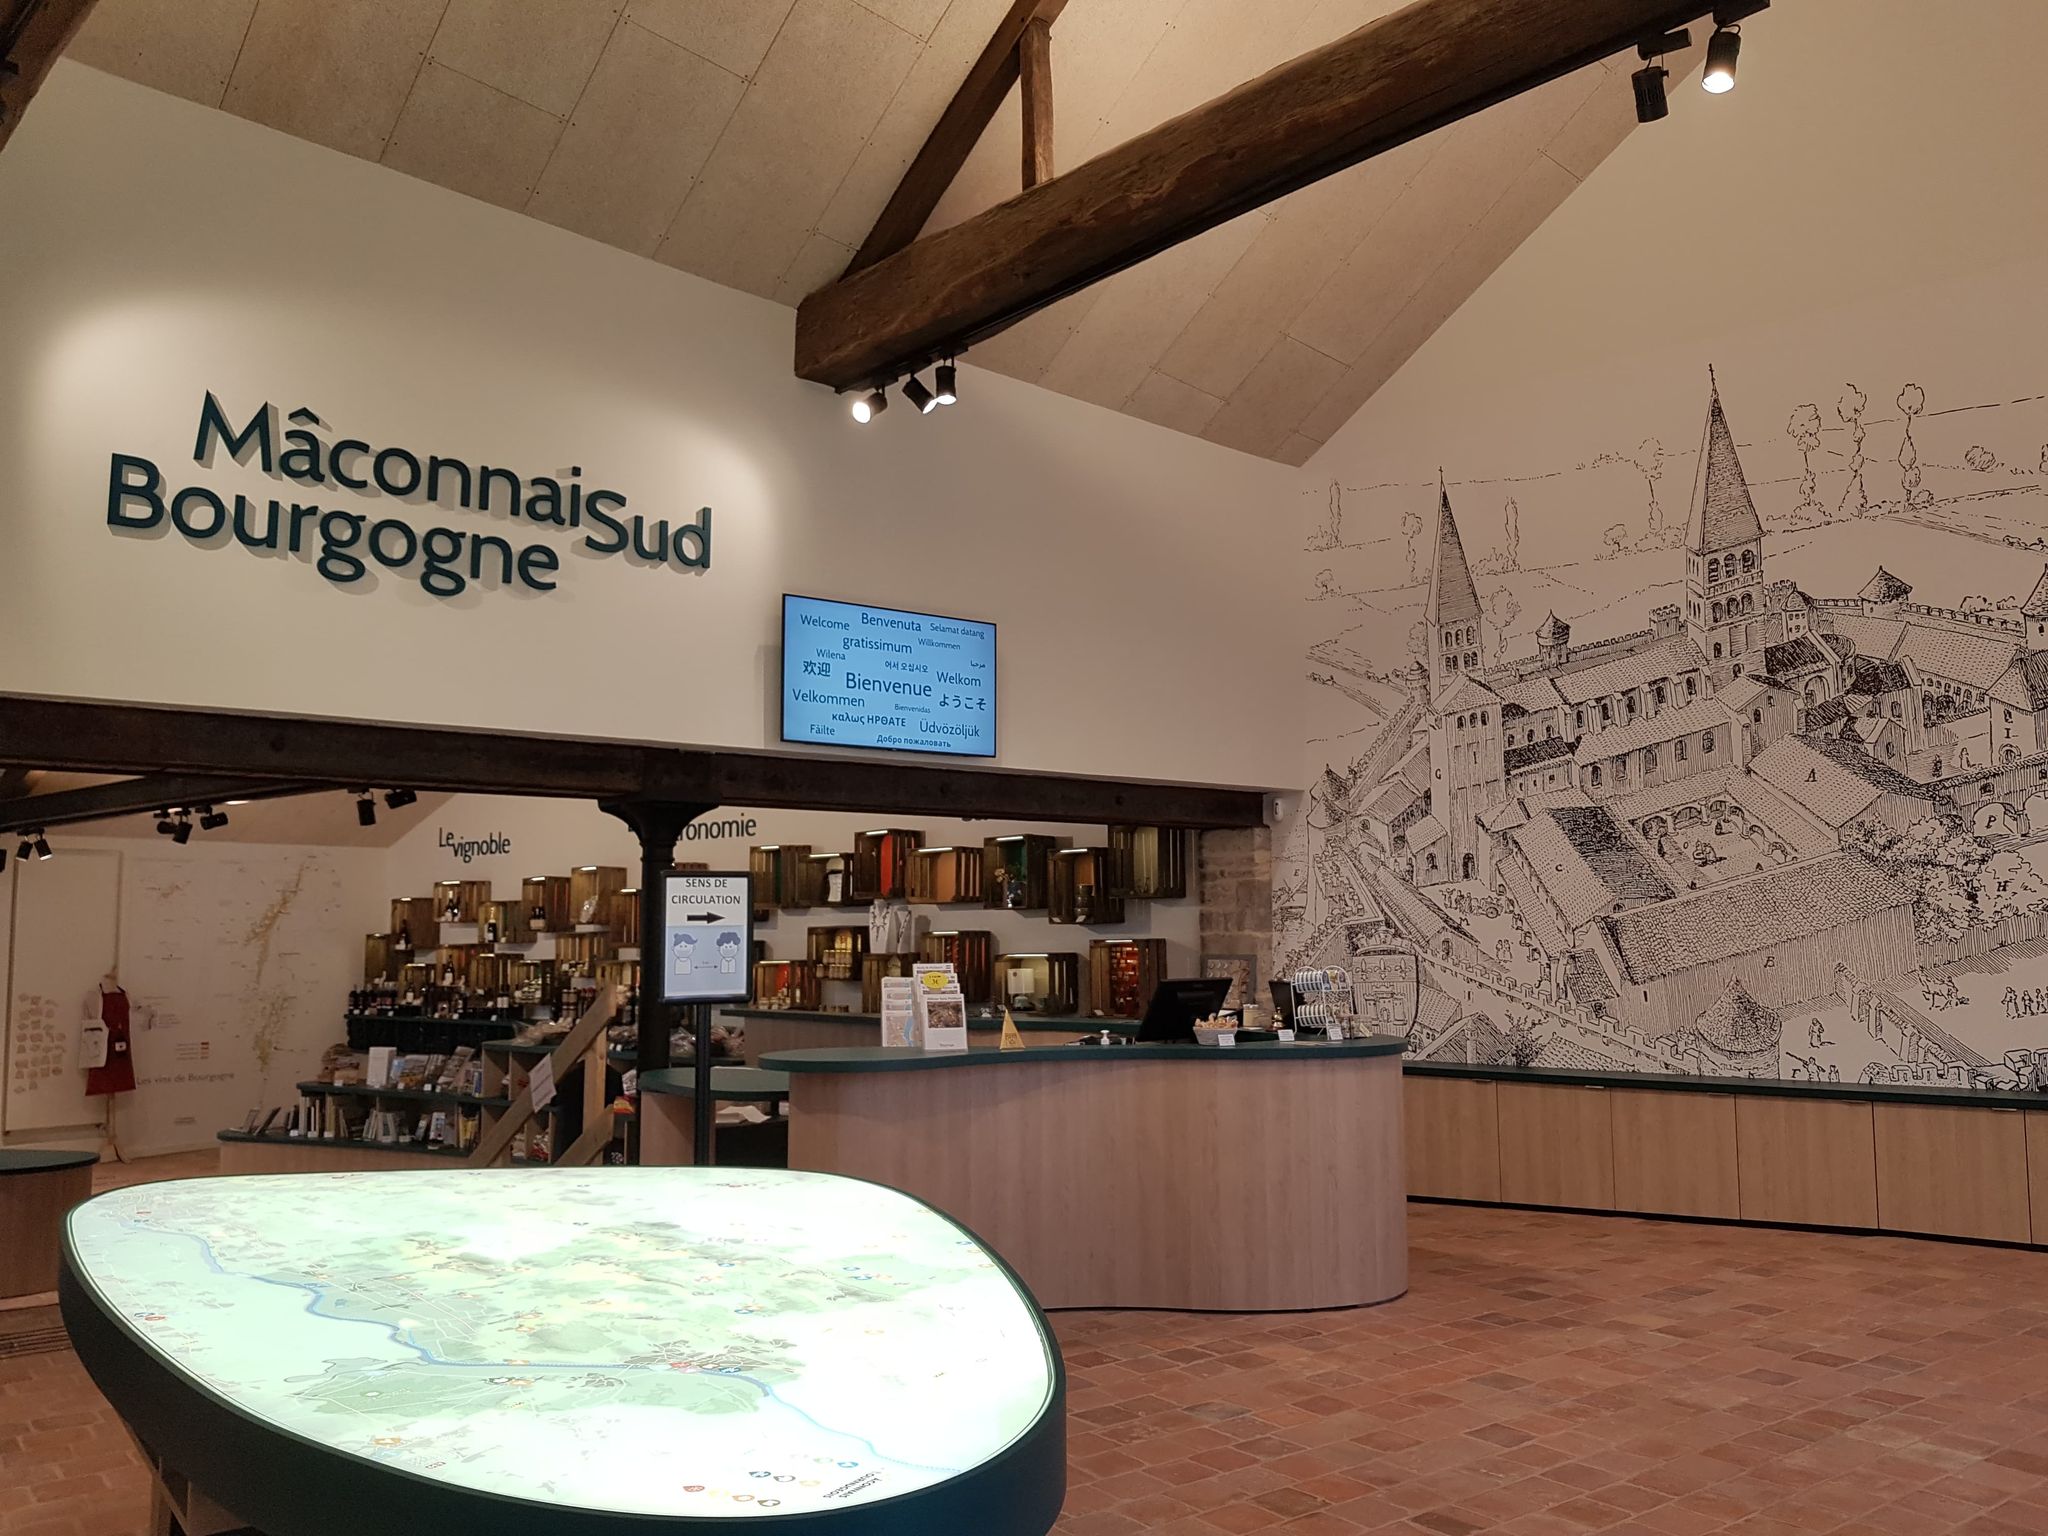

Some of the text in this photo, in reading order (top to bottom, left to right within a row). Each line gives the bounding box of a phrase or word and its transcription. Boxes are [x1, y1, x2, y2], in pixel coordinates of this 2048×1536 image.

[106, 452, 560, 597] Bourgogne
[800, 614, 850, 631] Welcome
[861, 612, 922, 632] Benvenuta
[930, 623, 985, 640] Selamat datang
[842, 636, 913, 654] gratissimum
[918, 638, 961, 650] Willkommen
[816, 648, 846, 661] Wilena
[802, 660, 831, 677] 欢迎
[884, 660, 929, 673] 어서 오십시오
[846, 672, 932, 697] Bienvenue
[936, 671, 982, 687] Welkom
[792, 688, 865, 707] Velkommen
[939, 693, 987, 711] ようこそ
[919, 718, 980, 740] Üdvözöljük
[876, 734, 952, 748] Добро пожаловать
[1804, 768, 1818, 783] A
[1985, 814, 1997, 830] P
[439, 827, 511, 864] Le vignoble
[685, 878, 728, 888] SENS DE
[671, 894, 741, 905] CIRCULATION
[1763, 956, 1775, 969] B
